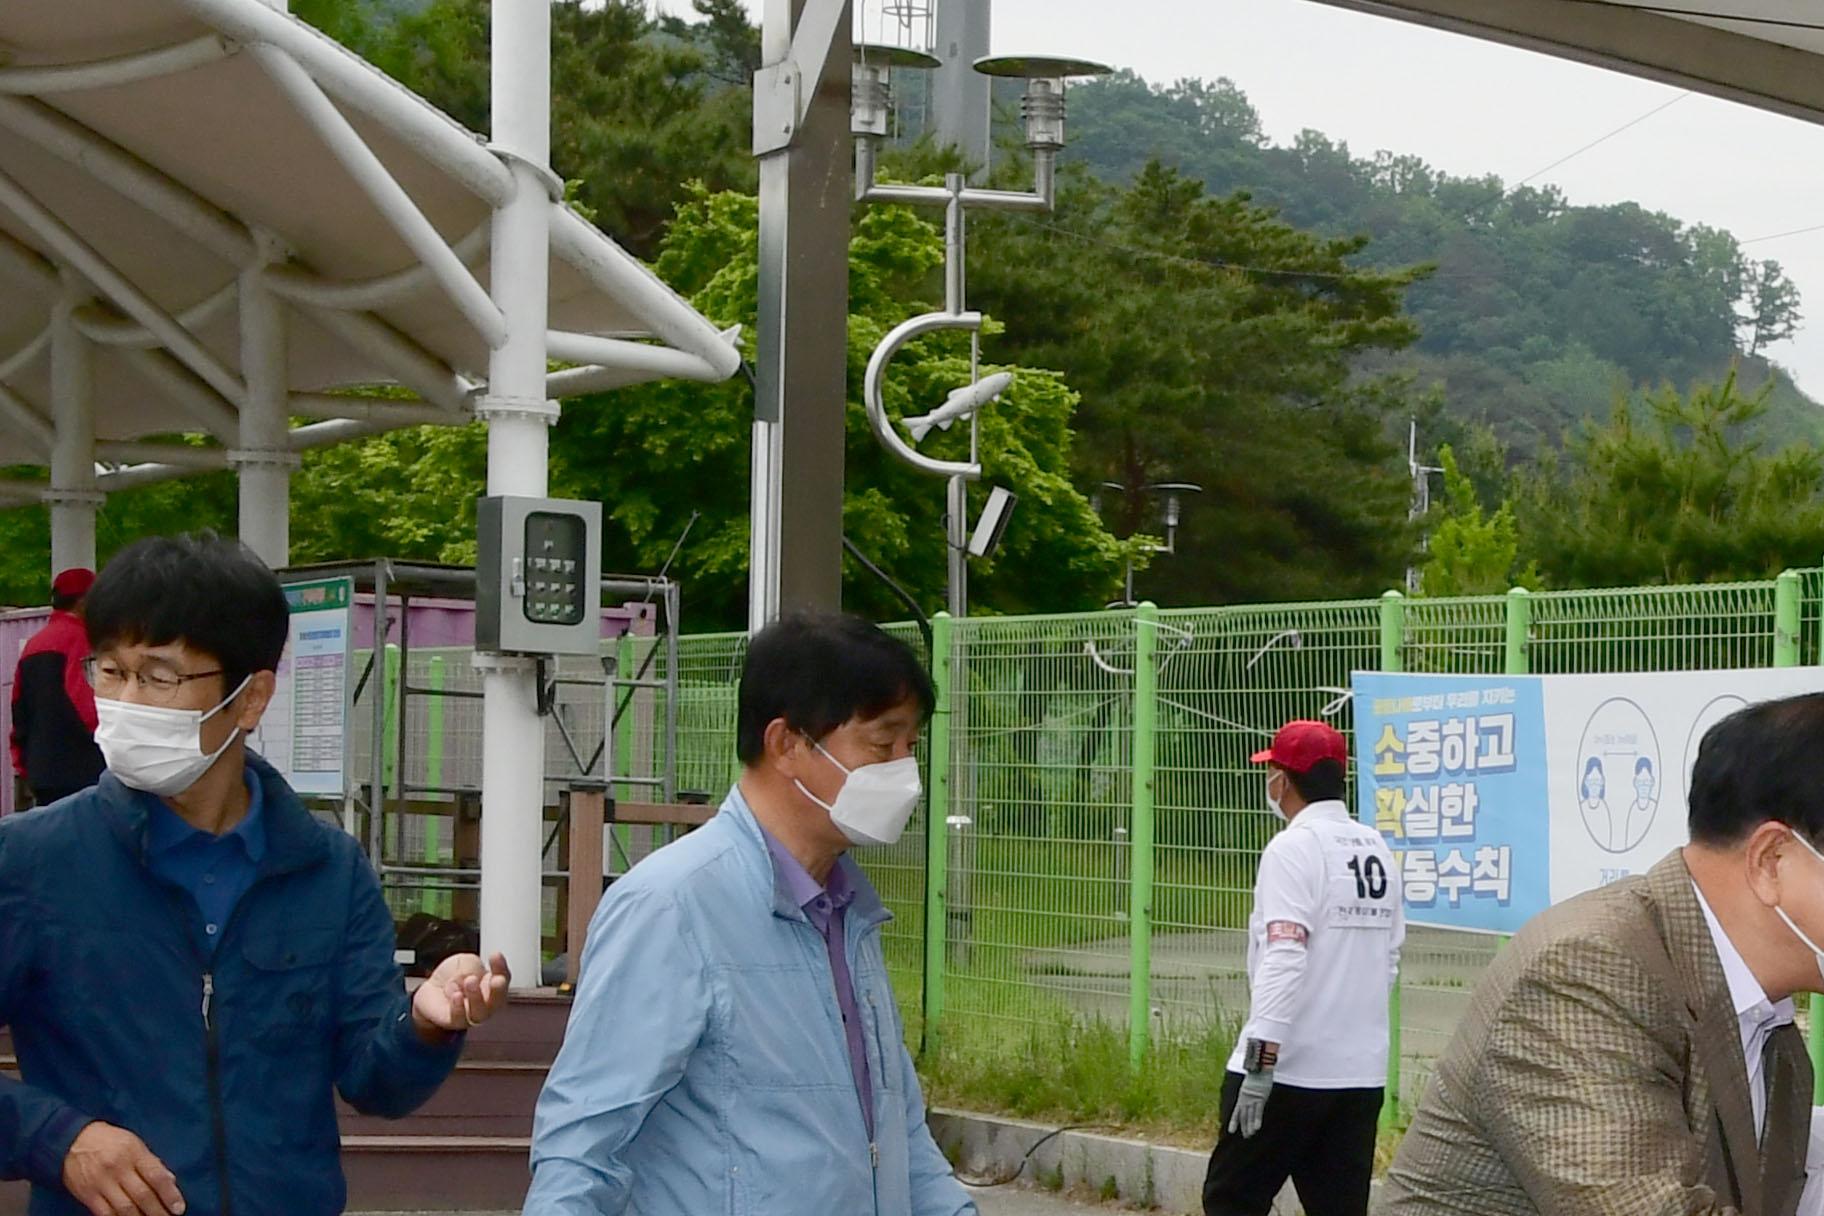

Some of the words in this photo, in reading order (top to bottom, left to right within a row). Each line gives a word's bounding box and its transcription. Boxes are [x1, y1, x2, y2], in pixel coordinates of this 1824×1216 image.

[1374, 713, 1516, 778] 소중하고
[1375, 783, 1479, 844] 확실한
[1347, 854, 1388, 899] 10
[1393, 846, 1512, 902] 동수칙
